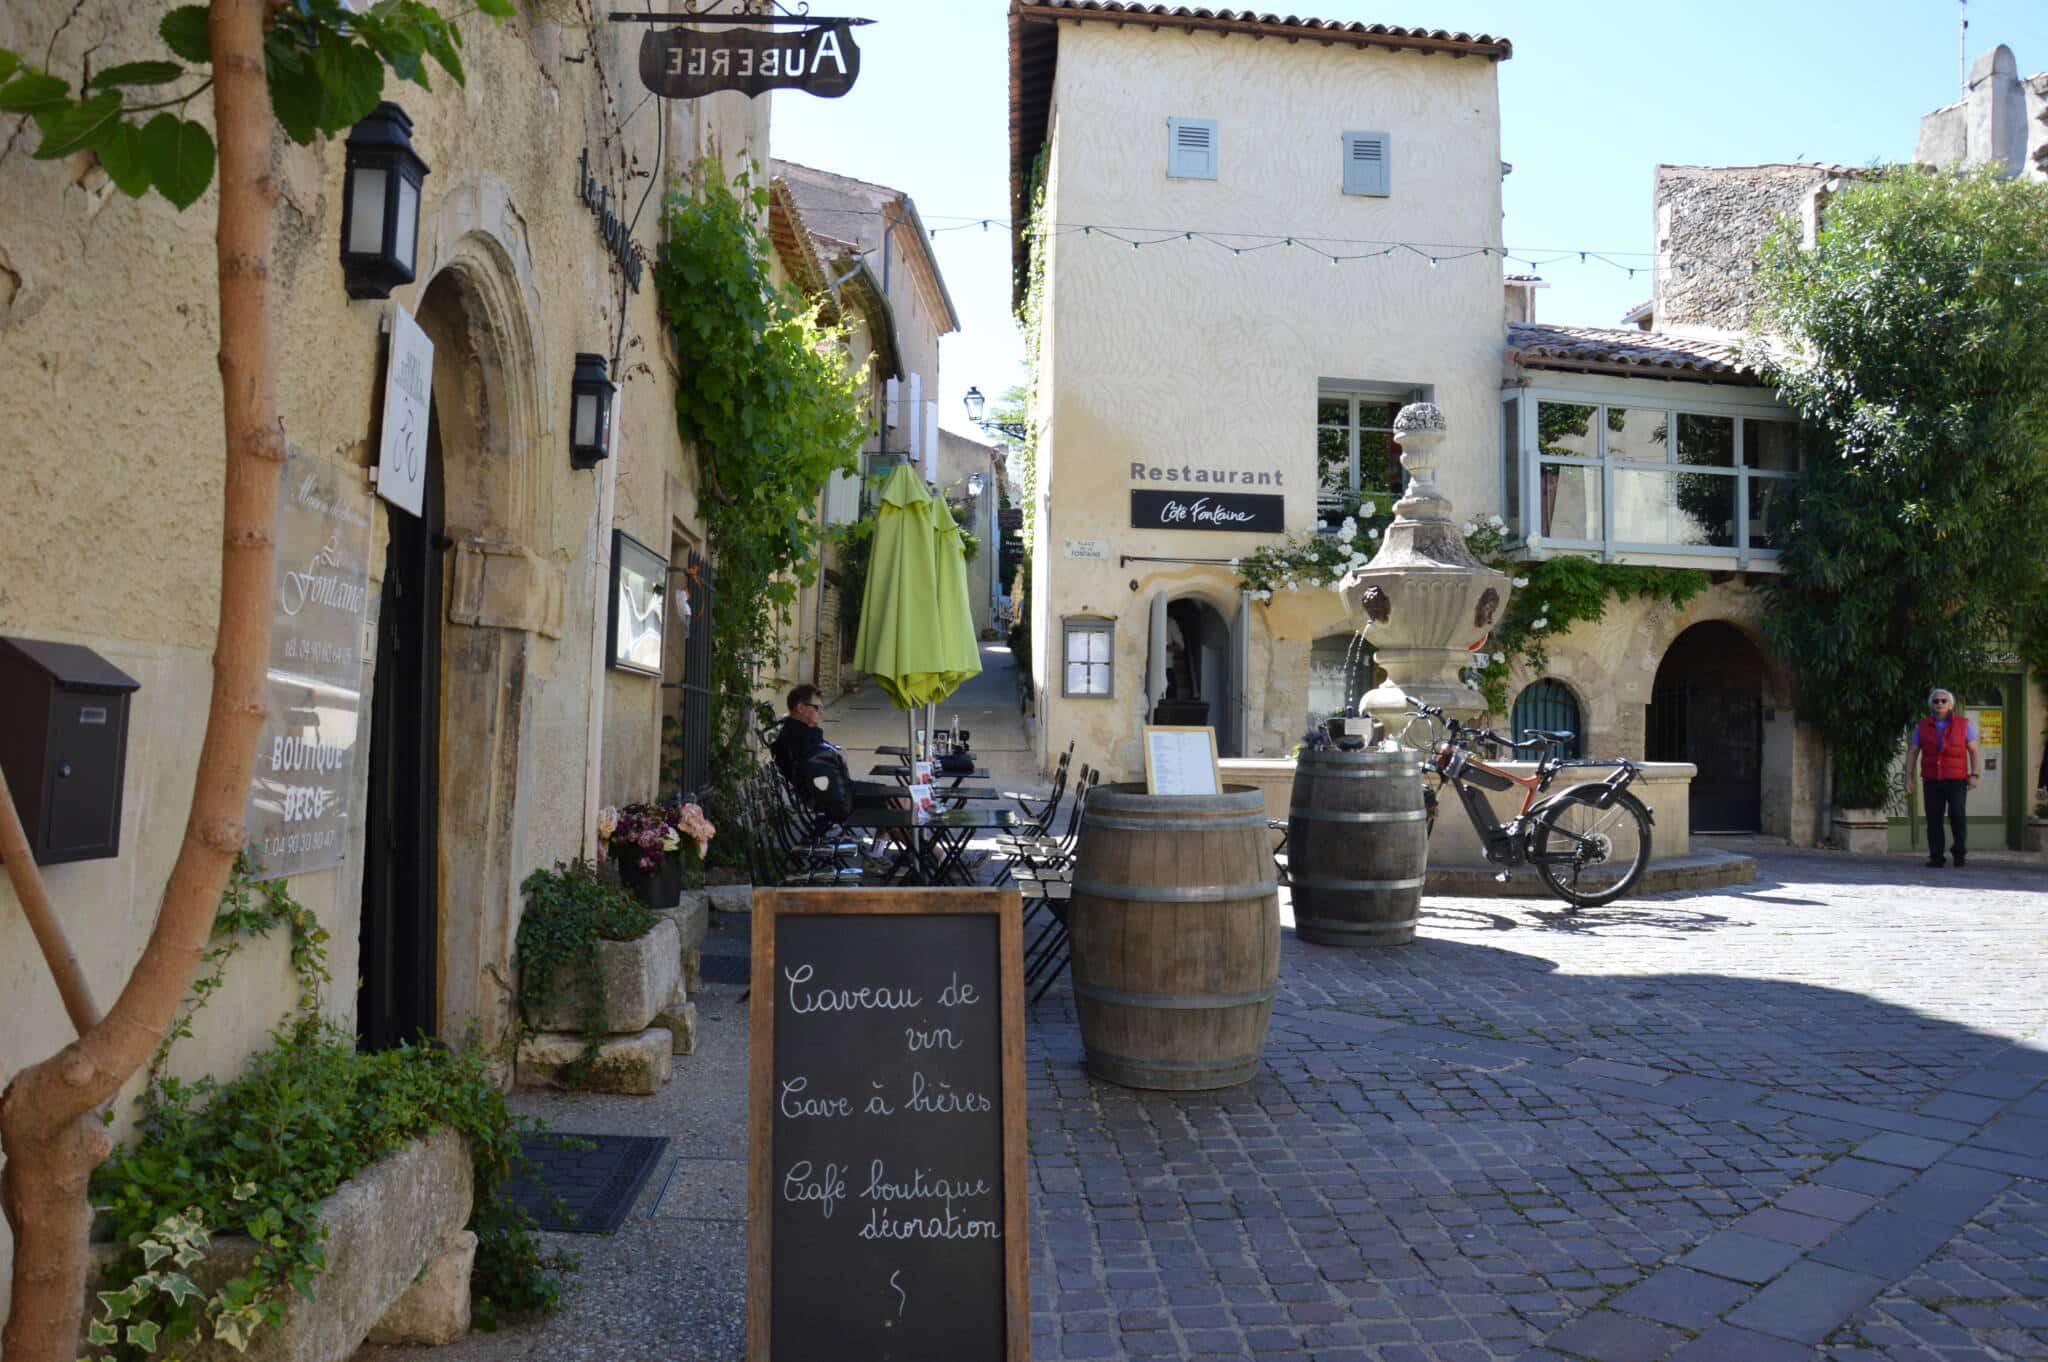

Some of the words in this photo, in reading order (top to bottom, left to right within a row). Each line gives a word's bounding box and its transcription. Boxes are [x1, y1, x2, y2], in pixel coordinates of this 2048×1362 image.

[1130, 462, 1284, 486] Restaurant
[1189, 497, 1257, 525] Fontaine
[282, 554, 364, 616] Fontaine
[271, 736, 343, 776] BOUTIQUE
[784, 964, 923, 1014] Caveau
[937, 971, 980, 1007] de
[905, 1018, 963, 1051] vin
[781, 1076, 854, 1118] Cave
[864, 1080, 895, 1116] à
[904, 1071, 993, 1113] bières
[784, 1160, 848, 1219] Café
[859, 1158, 990, 1209] boutique
[858, 1207, 1001, 1240] décoration
